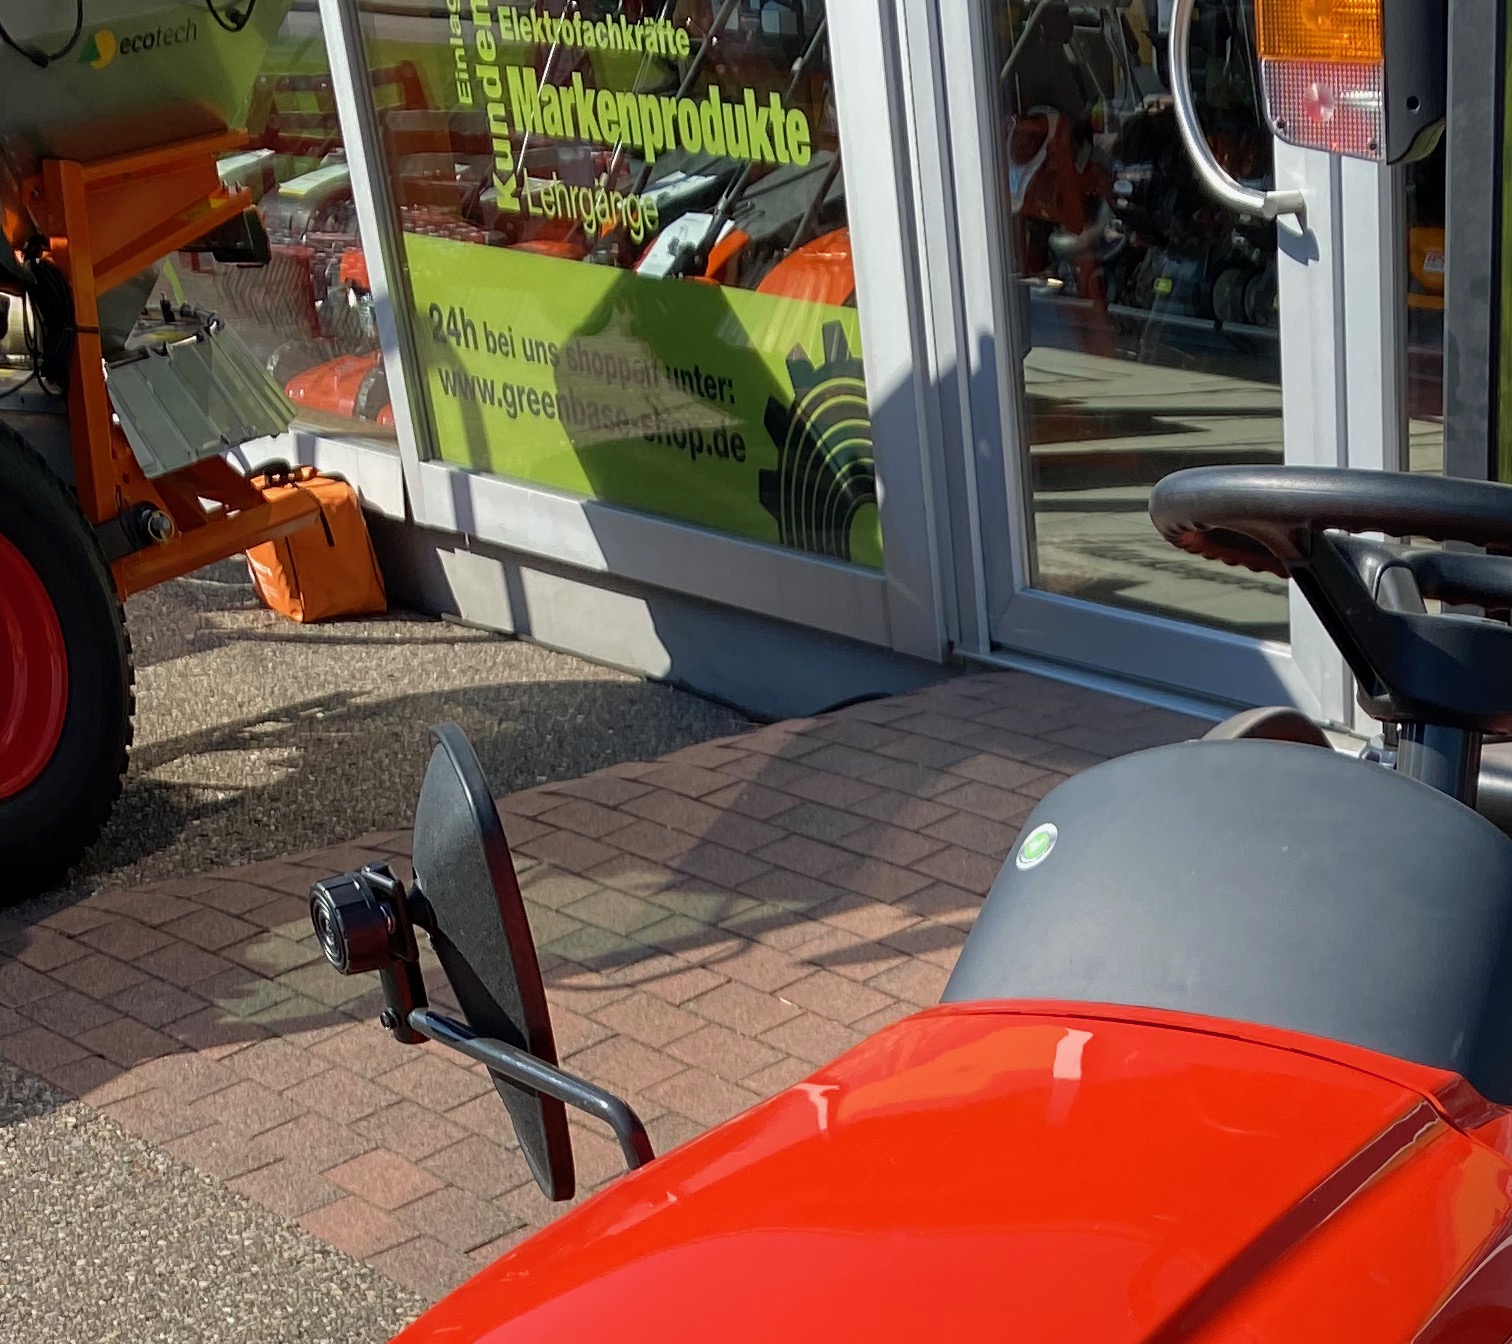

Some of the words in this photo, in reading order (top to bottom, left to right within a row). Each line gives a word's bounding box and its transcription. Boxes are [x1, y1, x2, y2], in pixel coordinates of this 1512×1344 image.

[119, 17, 198, 55] ecotech
[500, 6, 691, 57] Elektrofachkräfte
[506, 65, 812, 166] Markenprodukte
[524, 168, 659, 244] Lehrgänge
[428, 302, 479, 350] 24h
[483, 321, 517, 359] bei
[522, 336, 561, 367] uns
[566, 338, 660, 387] shoppen
[666, 363, 736, 404] unter:
[438, 368, 747, 463] www.greenbase-shop.de
